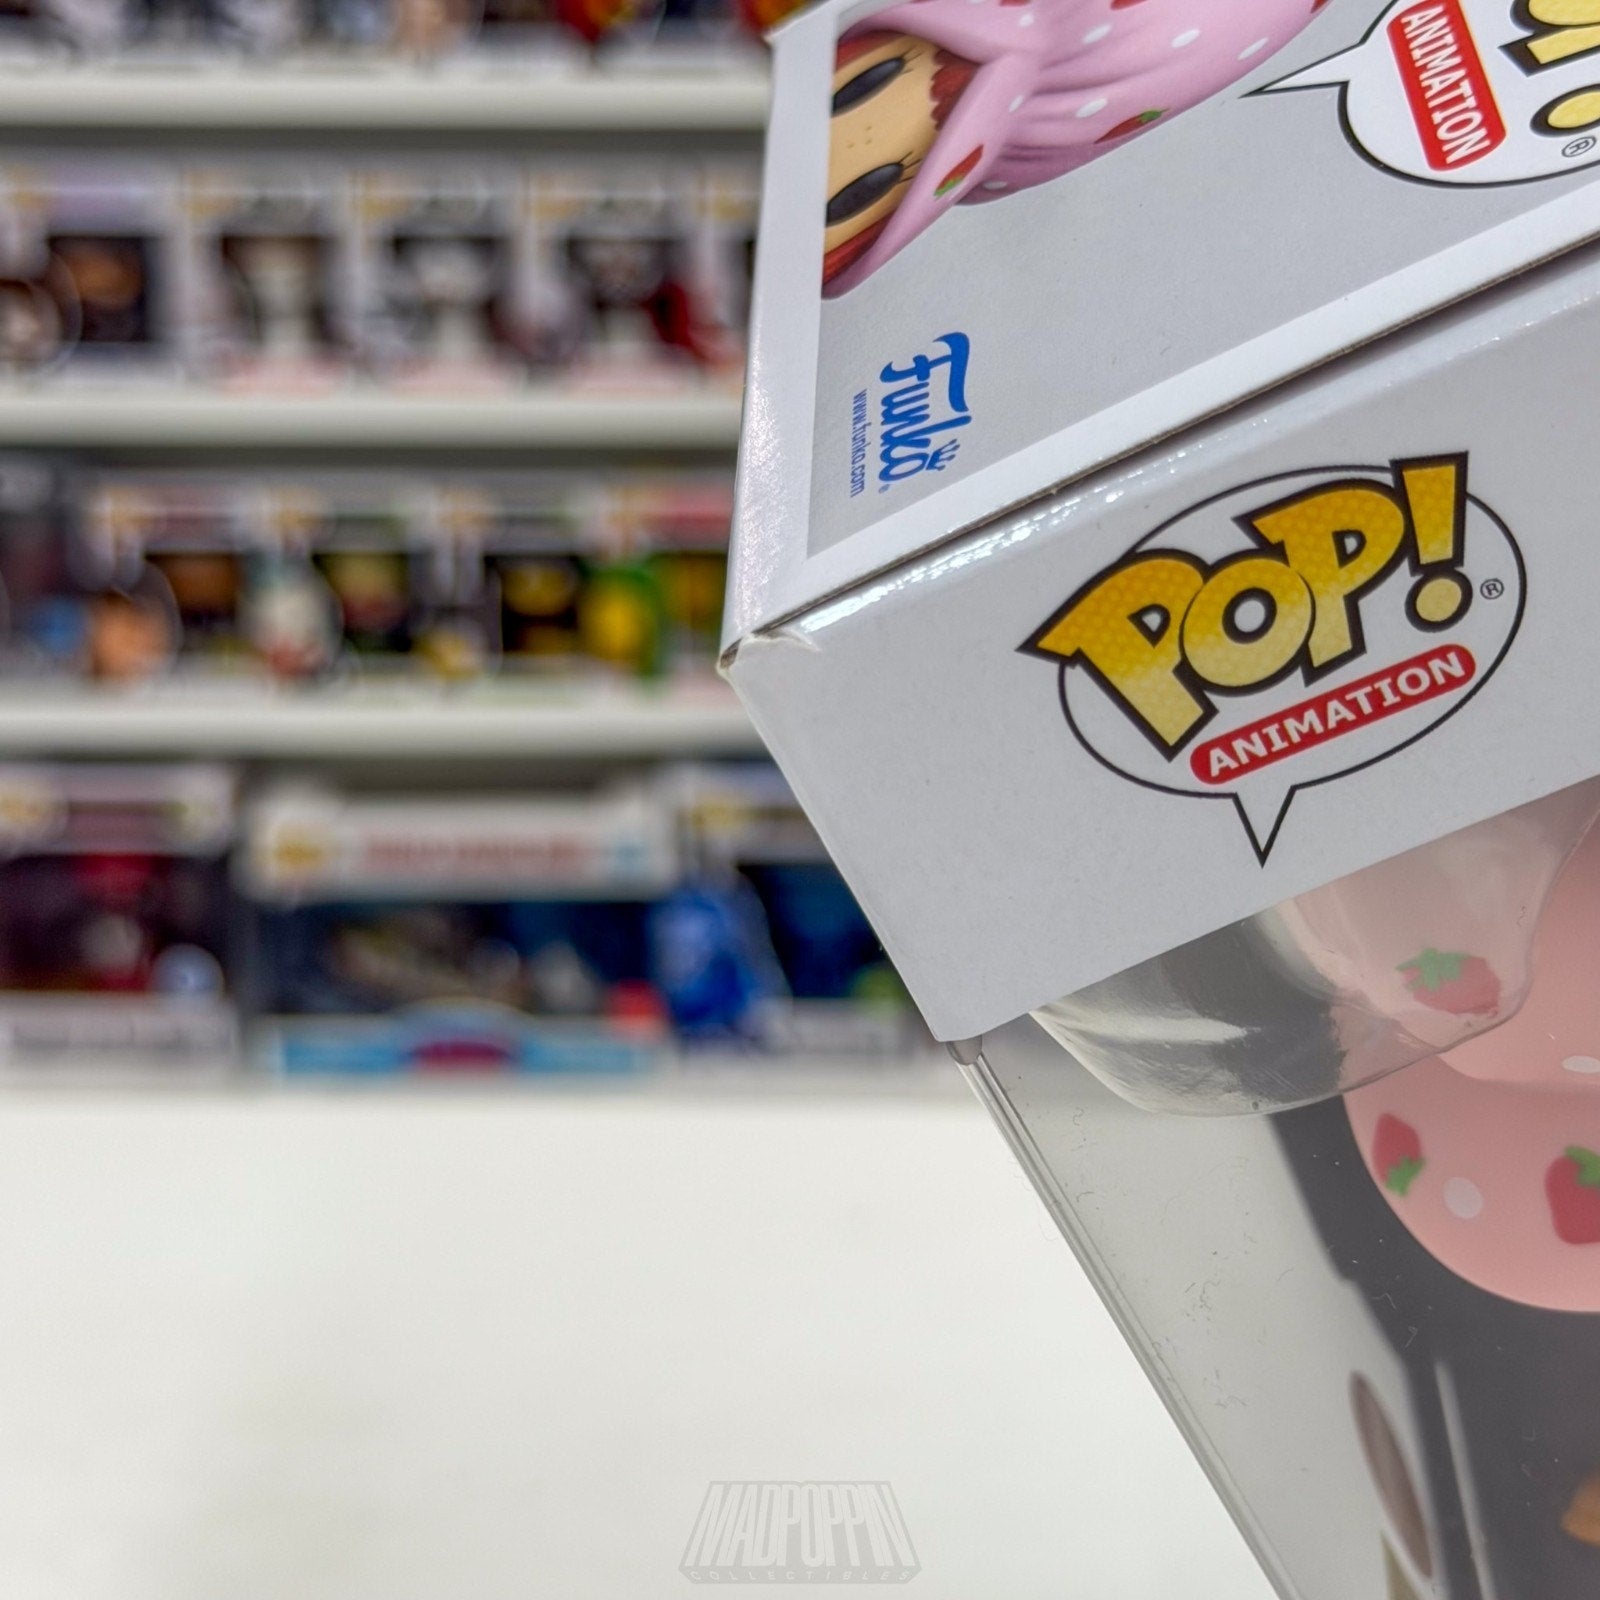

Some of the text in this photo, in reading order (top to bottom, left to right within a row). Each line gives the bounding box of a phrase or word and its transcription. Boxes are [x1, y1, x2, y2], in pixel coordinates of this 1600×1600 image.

[1401, 4, 1491, 165] ANIMATION
[850, 388, 872, 498] www.funko.com
[878, 331, 972, 482] Funko
[1209, 651, 1466, 778] ANIMATION
